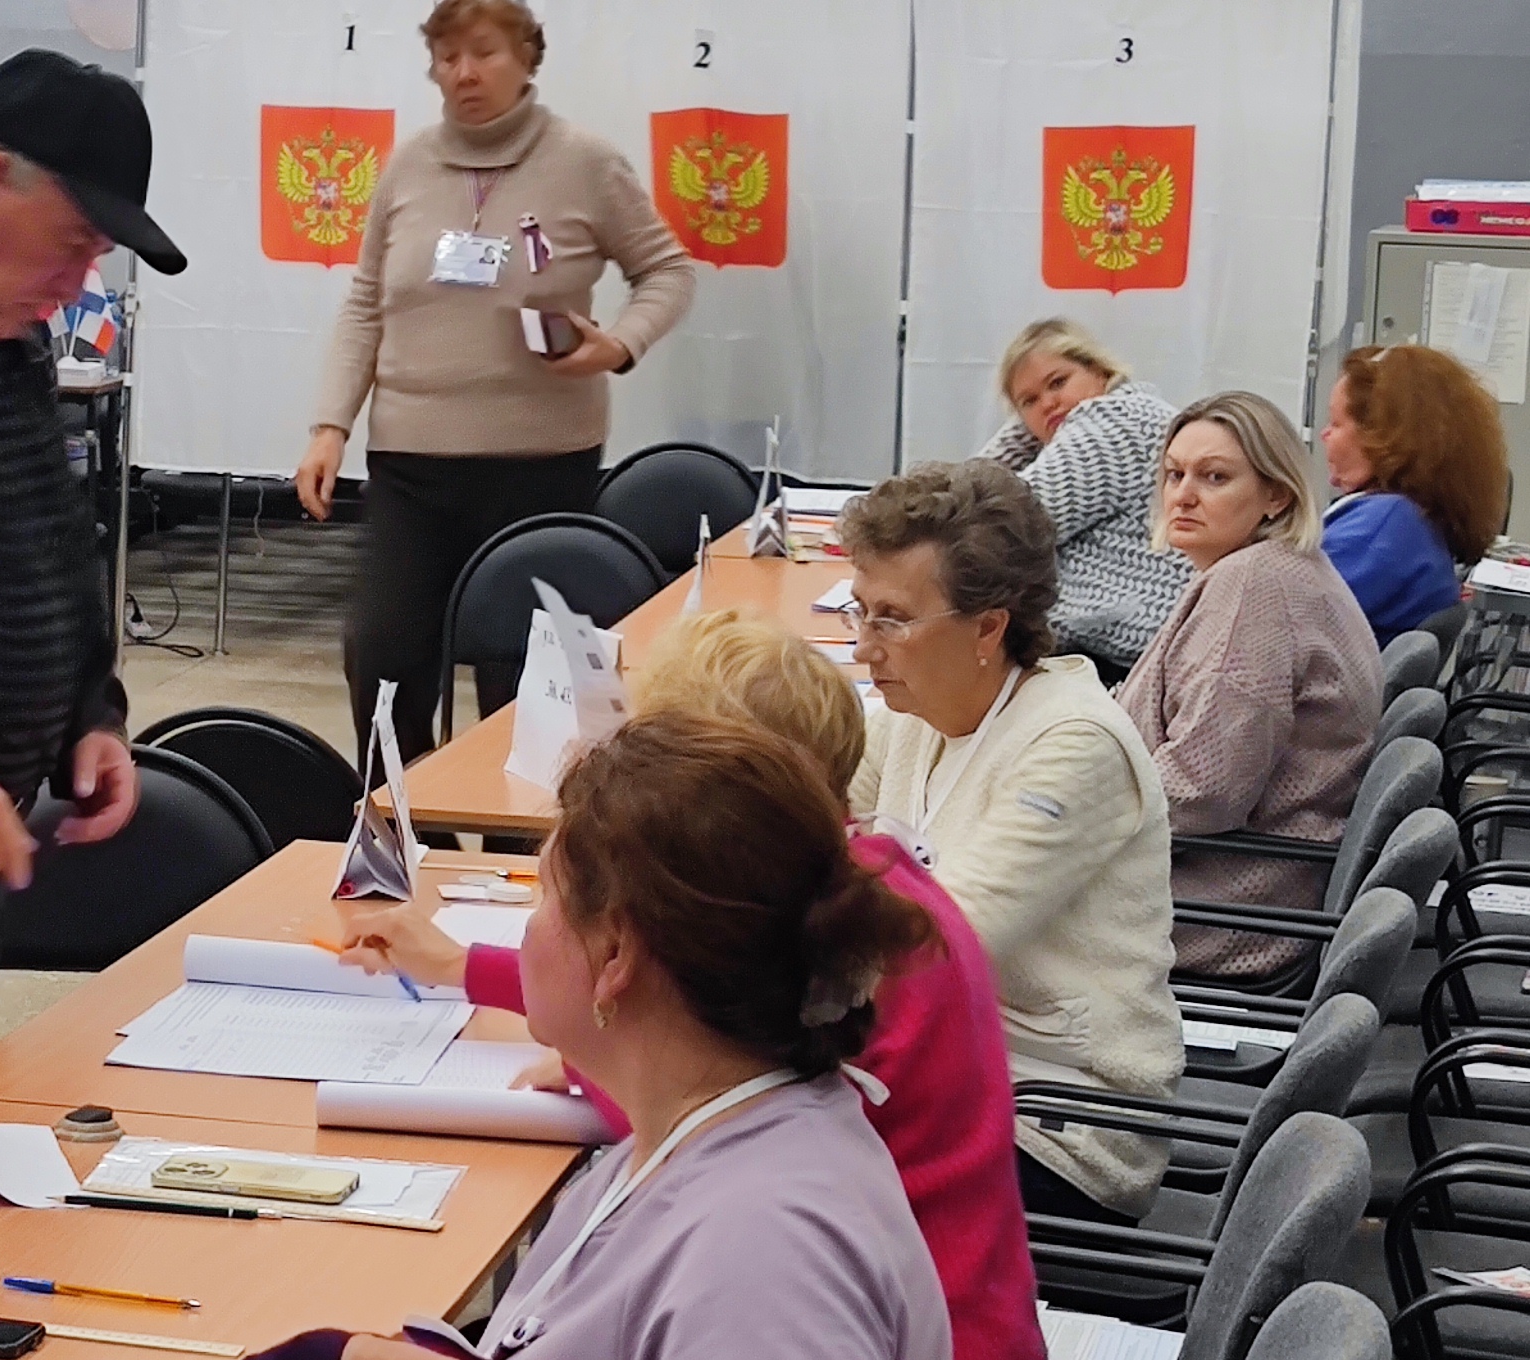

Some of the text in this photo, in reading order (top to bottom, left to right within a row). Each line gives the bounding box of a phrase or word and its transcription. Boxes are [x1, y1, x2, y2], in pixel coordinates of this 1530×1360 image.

[345, 24, 356, 51] 1
[1115, 37, 1134, 64] 3
[692, 41, 712, 69] 2
